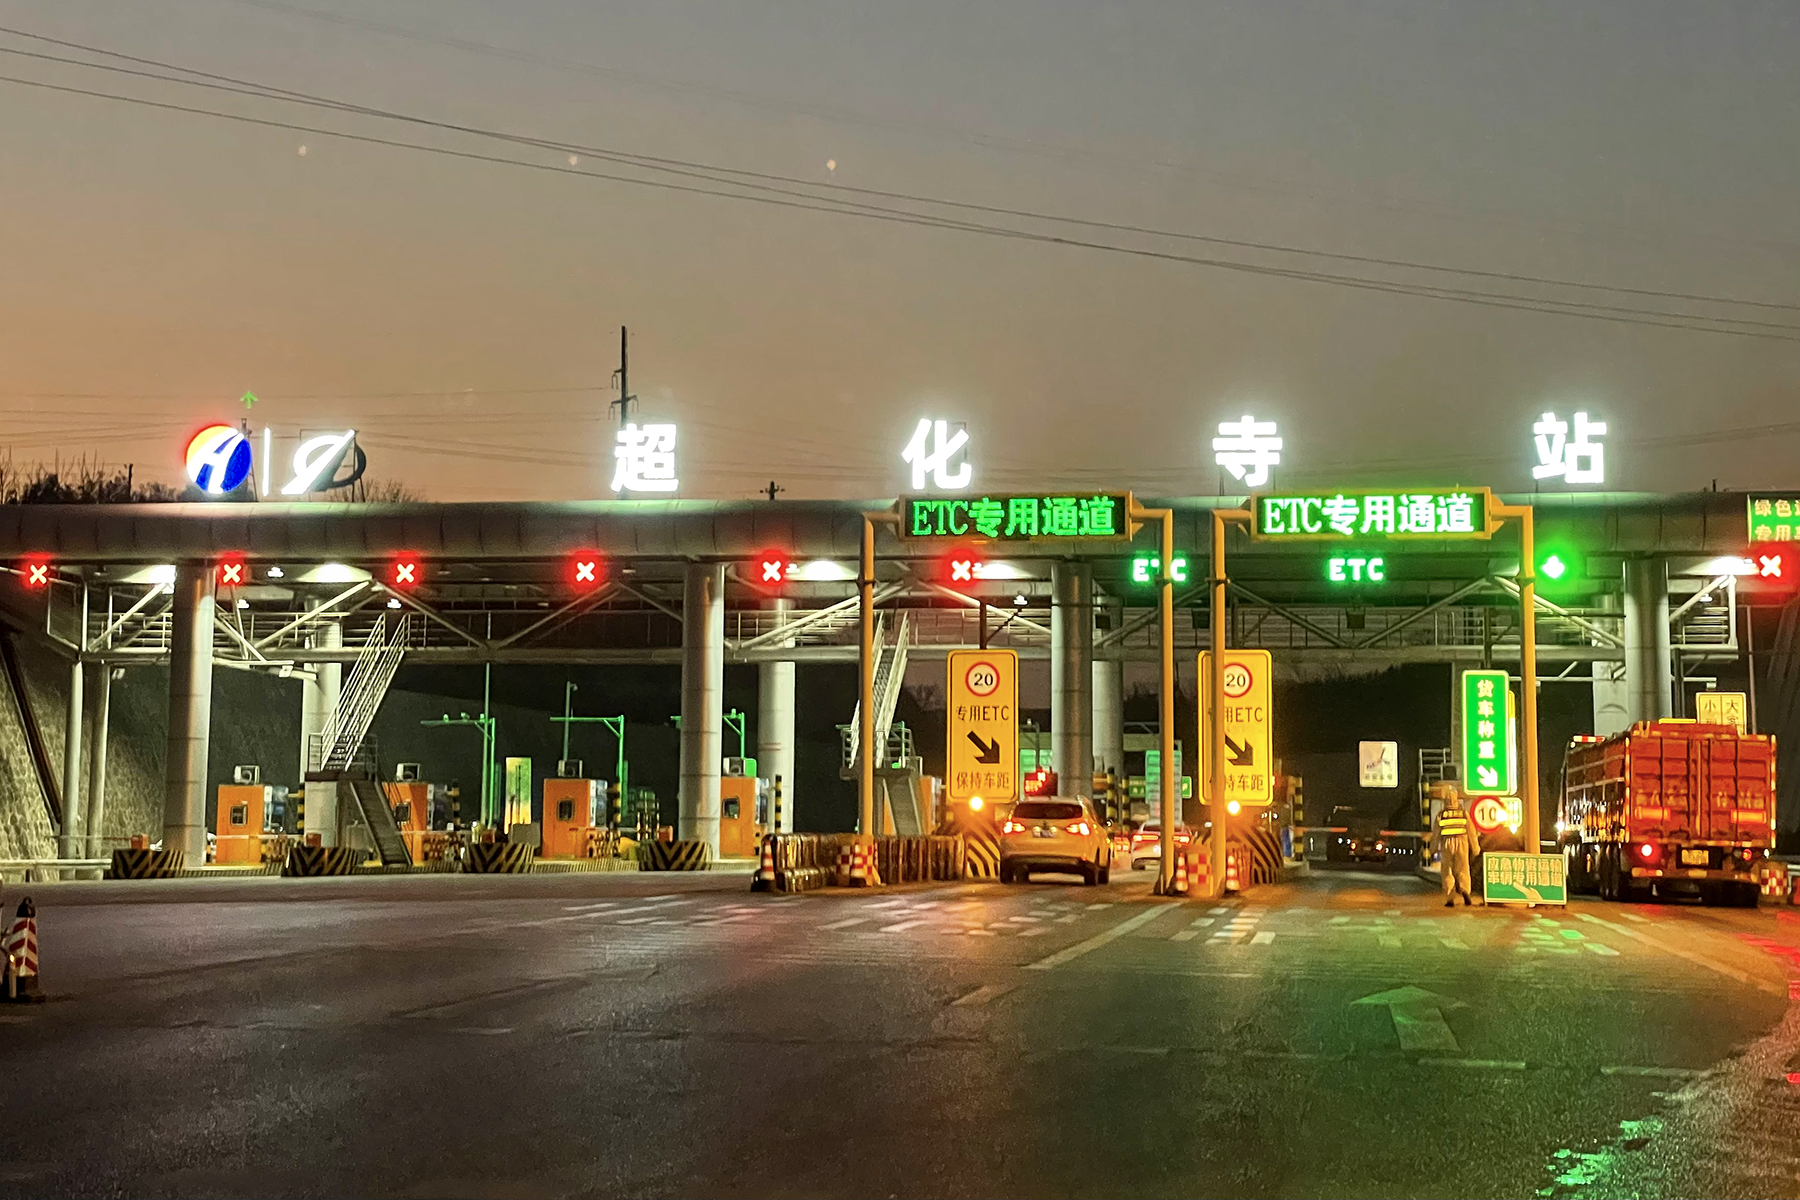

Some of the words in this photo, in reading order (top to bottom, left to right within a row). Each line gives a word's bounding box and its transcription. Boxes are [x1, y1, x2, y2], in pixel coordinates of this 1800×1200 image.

[611, 411, 1607, 494] 超化寺站
[912, 495, 1115, 538] ETC专用通道
[1263, 493, 1474, 536] ETC专用通道
[1329, 558, 1384, 582] ETC
[973, 672, 994, 687] 20
[1226, 673, 1246, 688] 20
[955, 704, 1010, 722] 专用ETC
[1208, 706, 1263, 723] 用ETC
[1477, 679, 1495, 759] 货车称重
[955, 771, 1010, 791] 保持车距
[1209, 772, 1265, 792] 持车距
[1480, 806, 1498, 823] 10
[1487, 870, 1563, 887] 车辆专用通道
